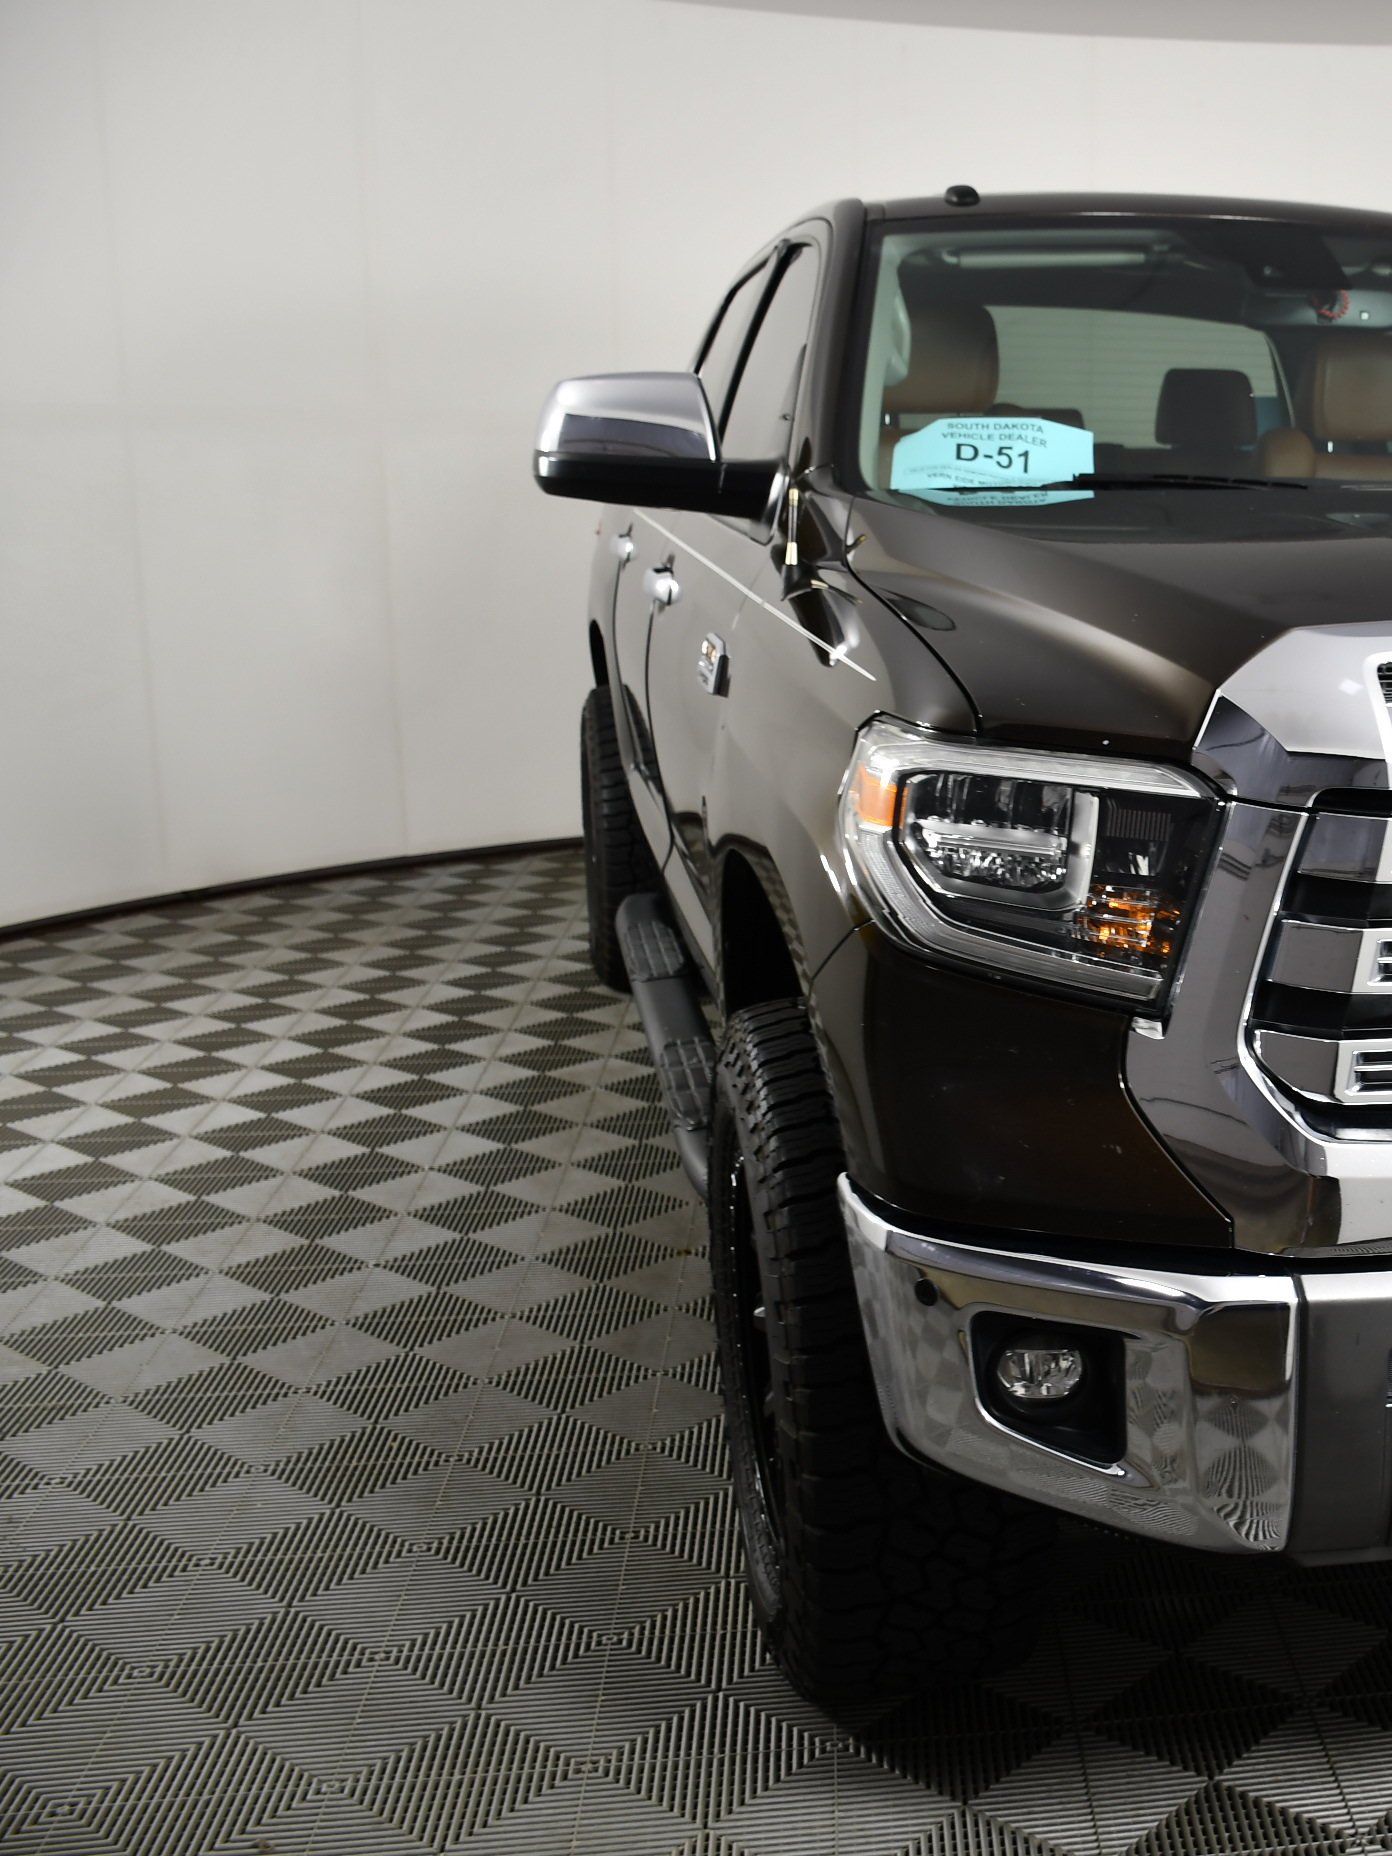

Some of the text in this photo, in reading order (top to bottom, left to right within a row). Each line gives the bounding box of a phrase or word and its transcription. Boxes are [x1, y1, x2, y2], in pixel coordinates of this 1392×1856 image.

[993, 423, 1044, 434] DAKOTA
[941, 432, 1048, 448] VEHICLE DEALER
[955, 443, 1029, 474] D-51
